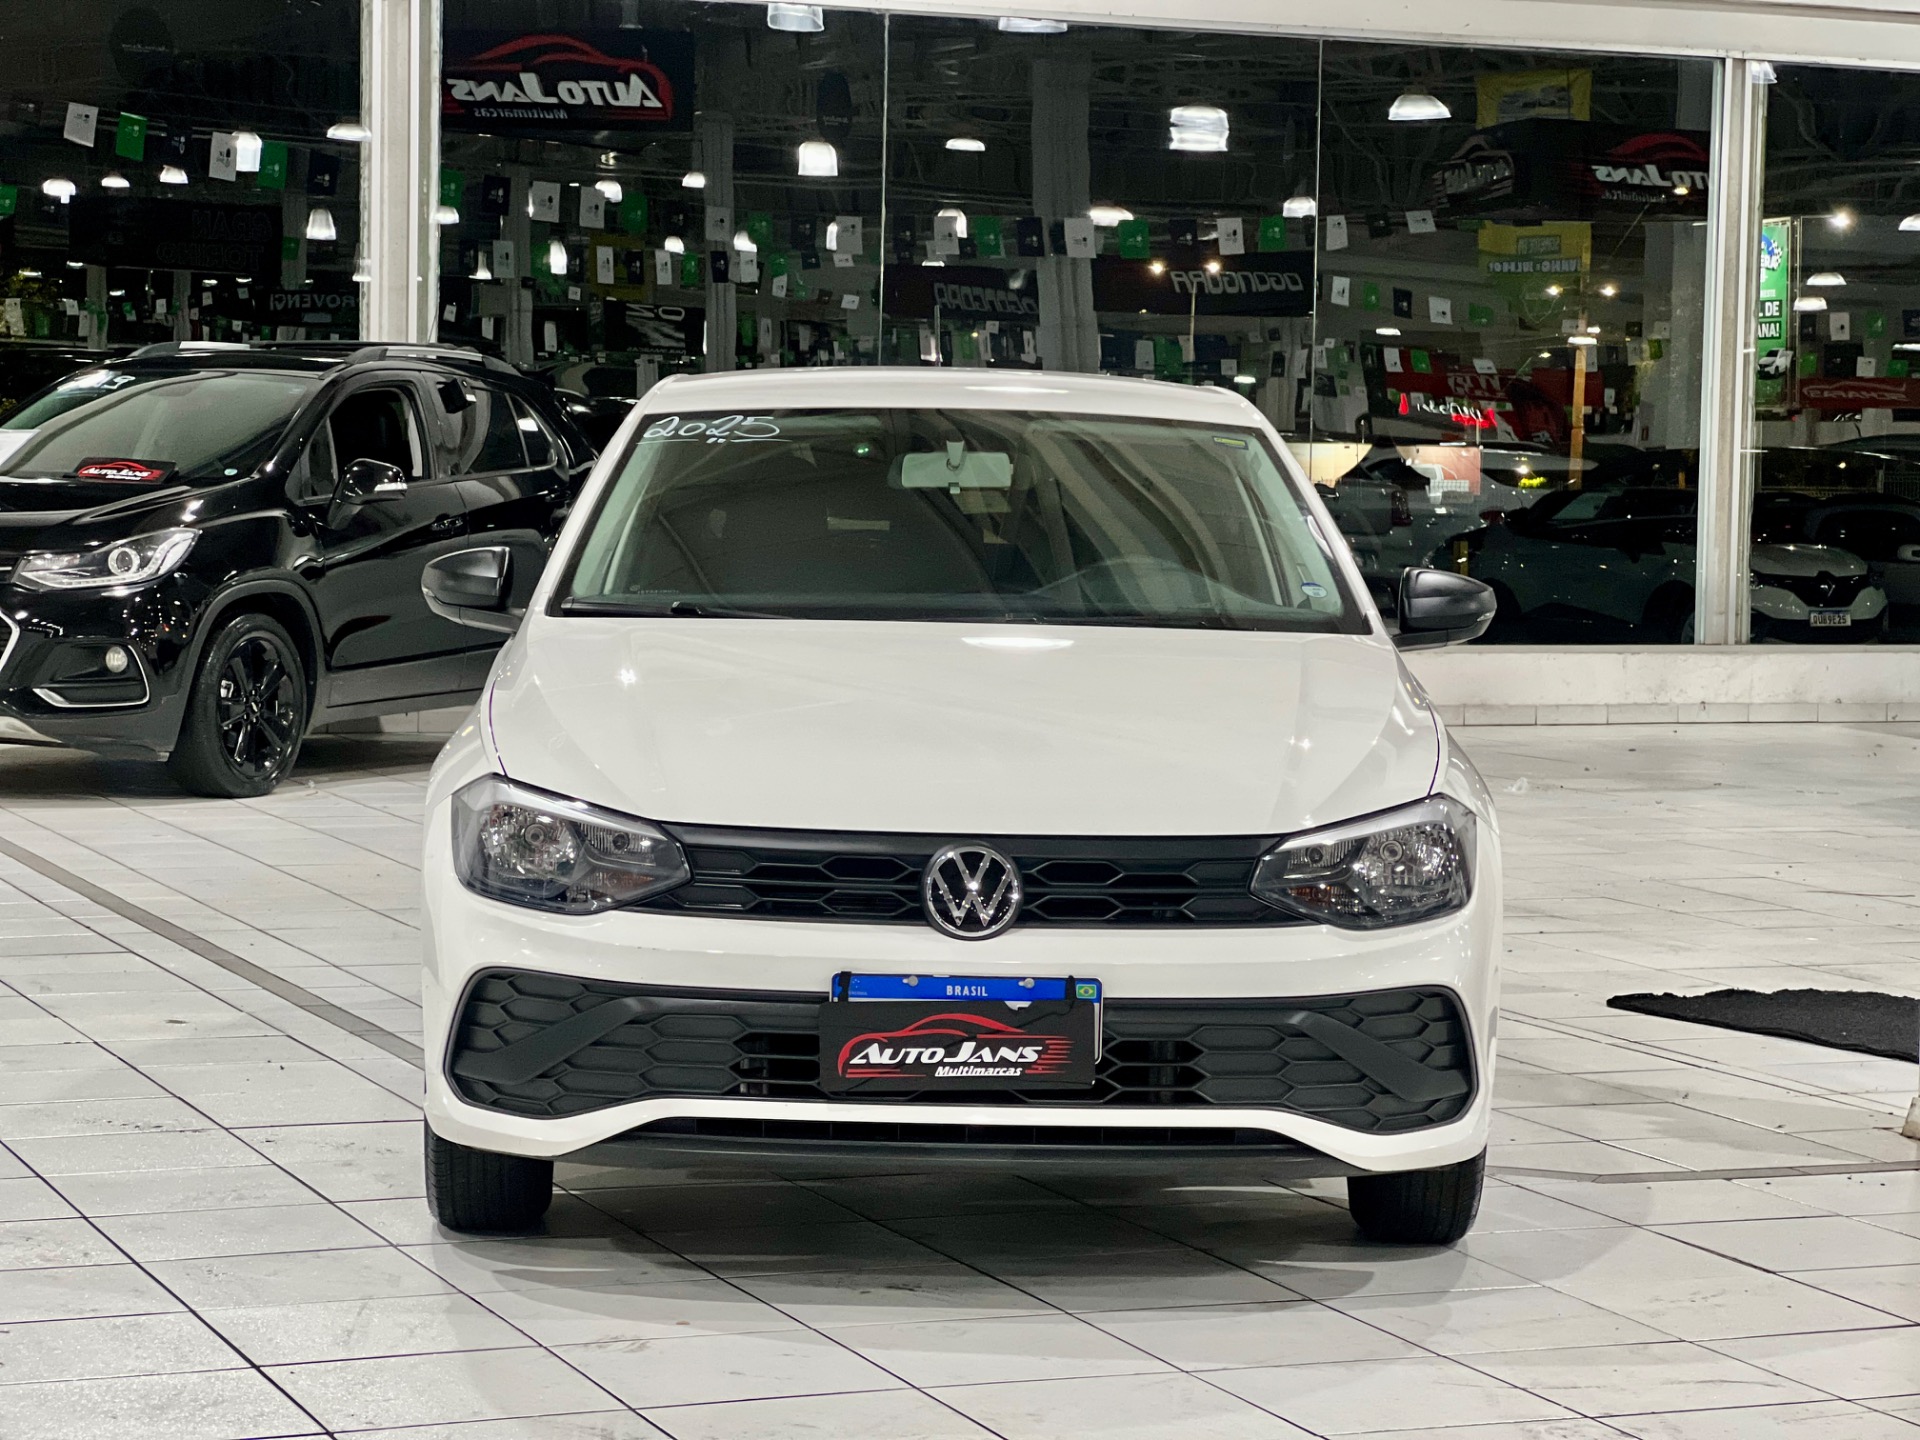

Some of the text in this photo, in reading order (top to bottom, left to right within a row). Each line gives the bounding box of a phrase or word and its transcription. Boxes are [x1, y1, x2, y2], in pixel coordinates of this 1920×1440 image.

[1764, 301, 1780, 317] DE
[643, 414, 780, 438] 2025
[946, 984, 988, 998] BRASIL
[934, 1065, 1023, 1078] Multimarcas
